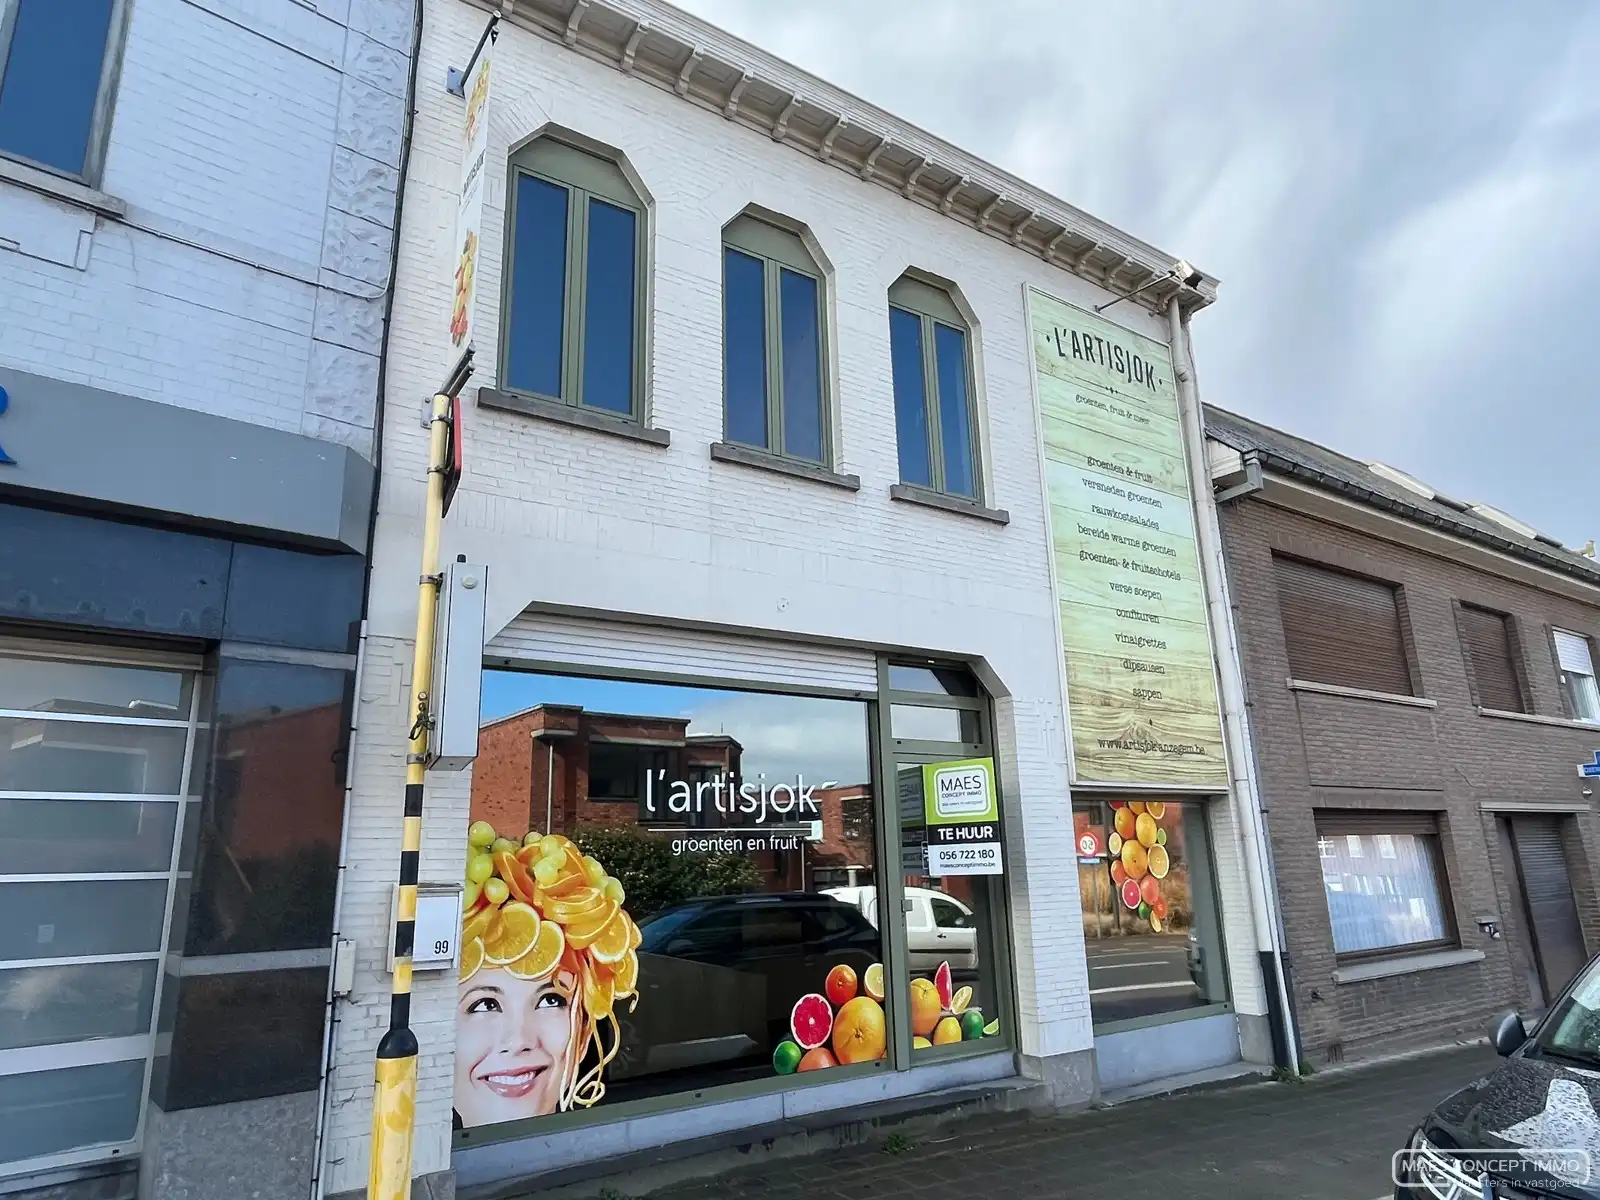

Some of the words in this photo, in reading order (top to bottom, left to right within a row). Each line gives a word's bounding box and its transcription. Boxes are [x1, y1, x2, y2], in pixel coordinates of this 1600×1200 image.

[1054, 327, 1156, 392] L'ARTISJOK
[1087, 456, 1125, 475] groenten
[1125, 466, 1133, 477] &
[1134, 469, 1154, 484] fruit
[1081, 478, 1126, 498] versneden
[1127, 491, 1163, 509] groenten
[1091, 504, 1160, 531] rauwkostsalades
[1077, 523, 1110, 541] bereide
[1111, 533, 1141, 549] warme
[1142, 541, 1177, 557] groenten
[1122, 558, 1130, 570] &
[1131, 560, 1182, 581] fruitschotels
[1109, 581, 1133, 595] verse
[1134, 587, 1163, 601] soepen
[1116, 608, 1161, 624] confituren
[1114, 632, 1168, 650] vinaigrettes
[1123, 659, 1166, 675] dipsausen
[1132, 687, 1163, 701] sappen
[940, 775, 982, 792] MAES
[646, 769, 818, 824] l'artisjok
[937, 828, 954, 840] TE
[955, 826, 993, 840] HUUR
[671, 836, 743, 856] groenten
[747, 838, 766, 851] en
[770, 834, 799, 850] fruit
[939, 851, 957, 860] 056
[959, 850, 976, 859] 722
[977, 849, 995, 859] 180
[434, 940, 449, 954] 99
